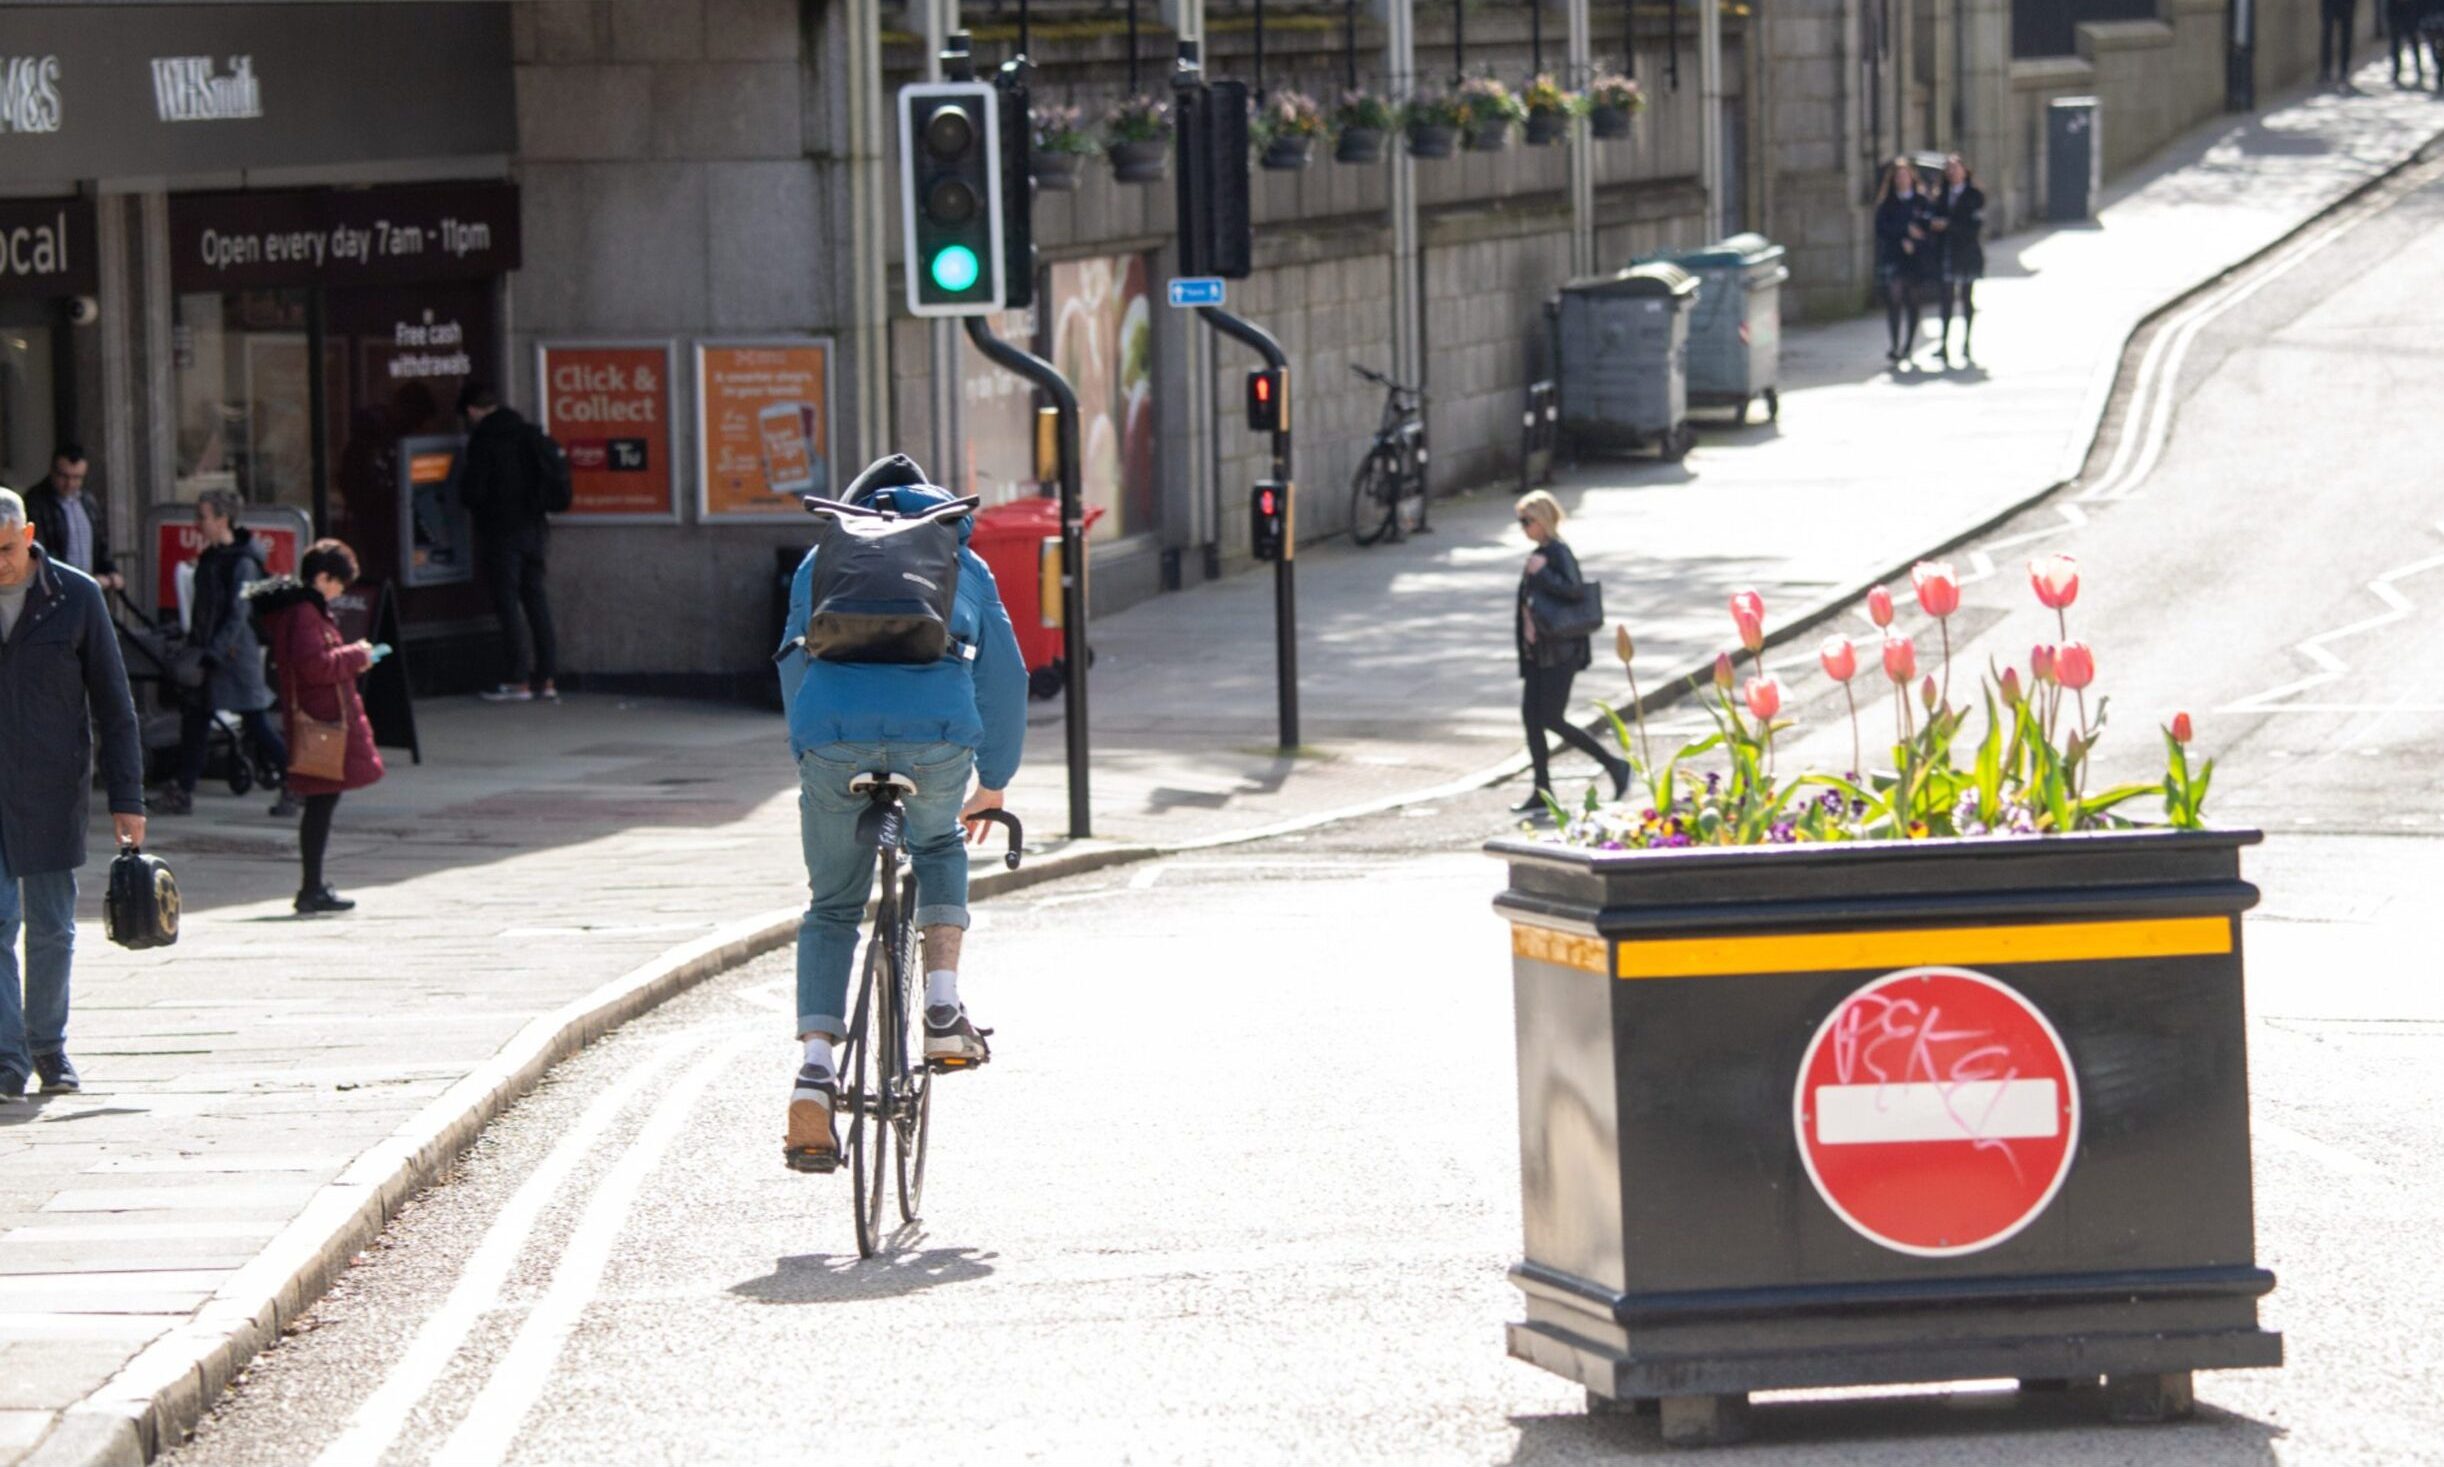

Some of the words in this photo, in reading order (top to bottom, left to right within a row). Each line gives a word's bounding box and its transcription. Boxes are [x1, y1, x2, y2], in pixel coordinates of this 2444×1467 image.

[151, 54, 263, 121] WHSmith
[202, 229, 260, 270] Open
[264, 230, 327, 267] every
[331, 223, 371, 264] day
[375, 219, 423, 255] 7am
[440, 218, 491, 258] 11pm
[395, 320, 427, 347] Free
[429, 317, 462, 345] cash
[389, 344, 471, 378] withdrawals
[553, 364, 626, 393] Click
[634, 365, 658, 393] &
[554, 394, 657, 423] Collect
[613, 442, 642, 467] Tu
